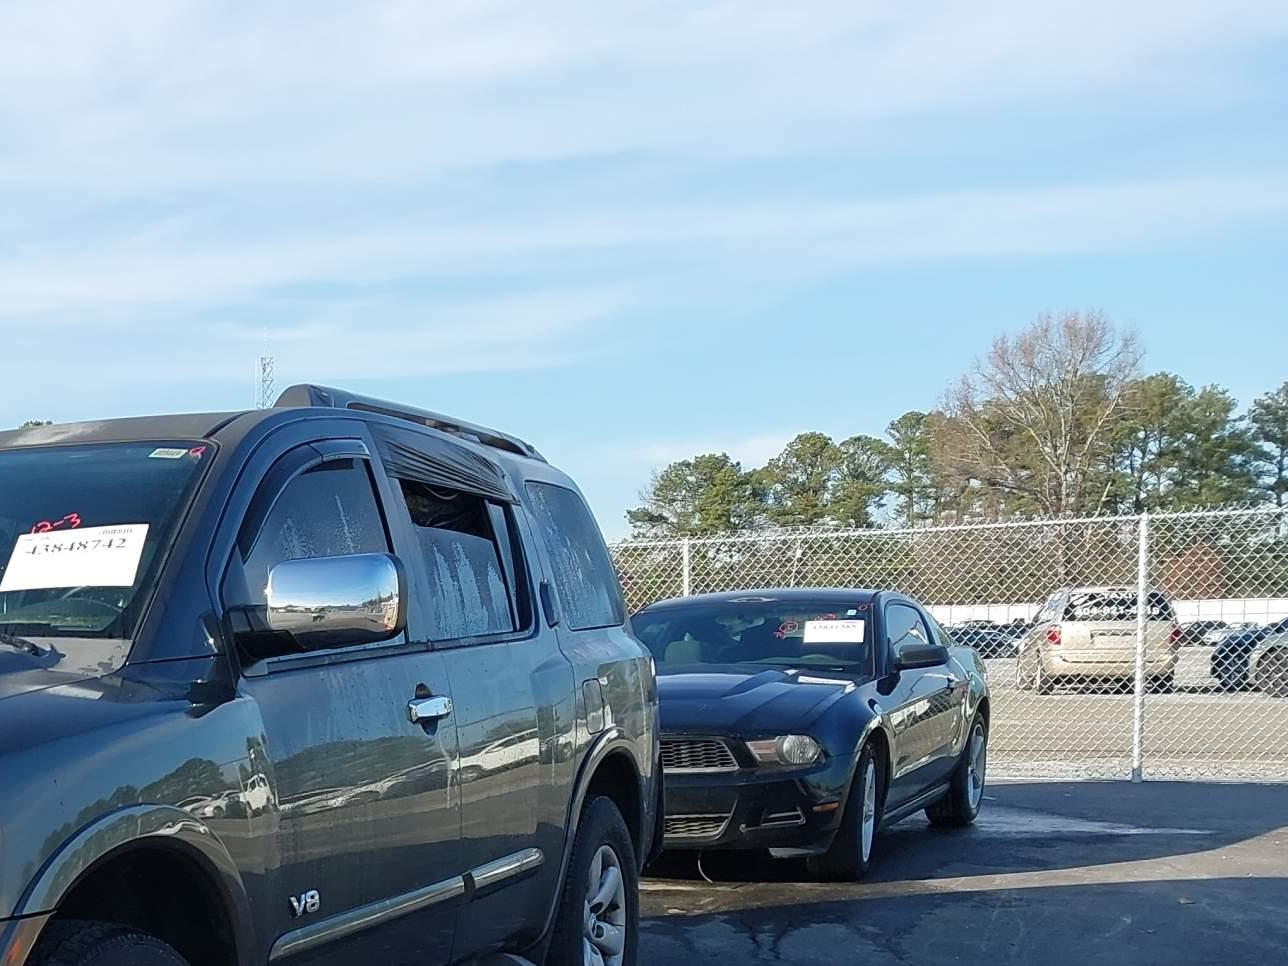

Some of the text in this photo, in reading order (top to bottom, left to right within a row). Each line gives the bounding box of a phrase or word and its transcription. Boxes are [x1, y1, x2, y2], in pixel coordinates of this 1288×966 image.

[26, 538, 126, 555] 43848742
[1075, 606, 1160, 616] 404-821-419
[289, 890, 320, 916] V8
